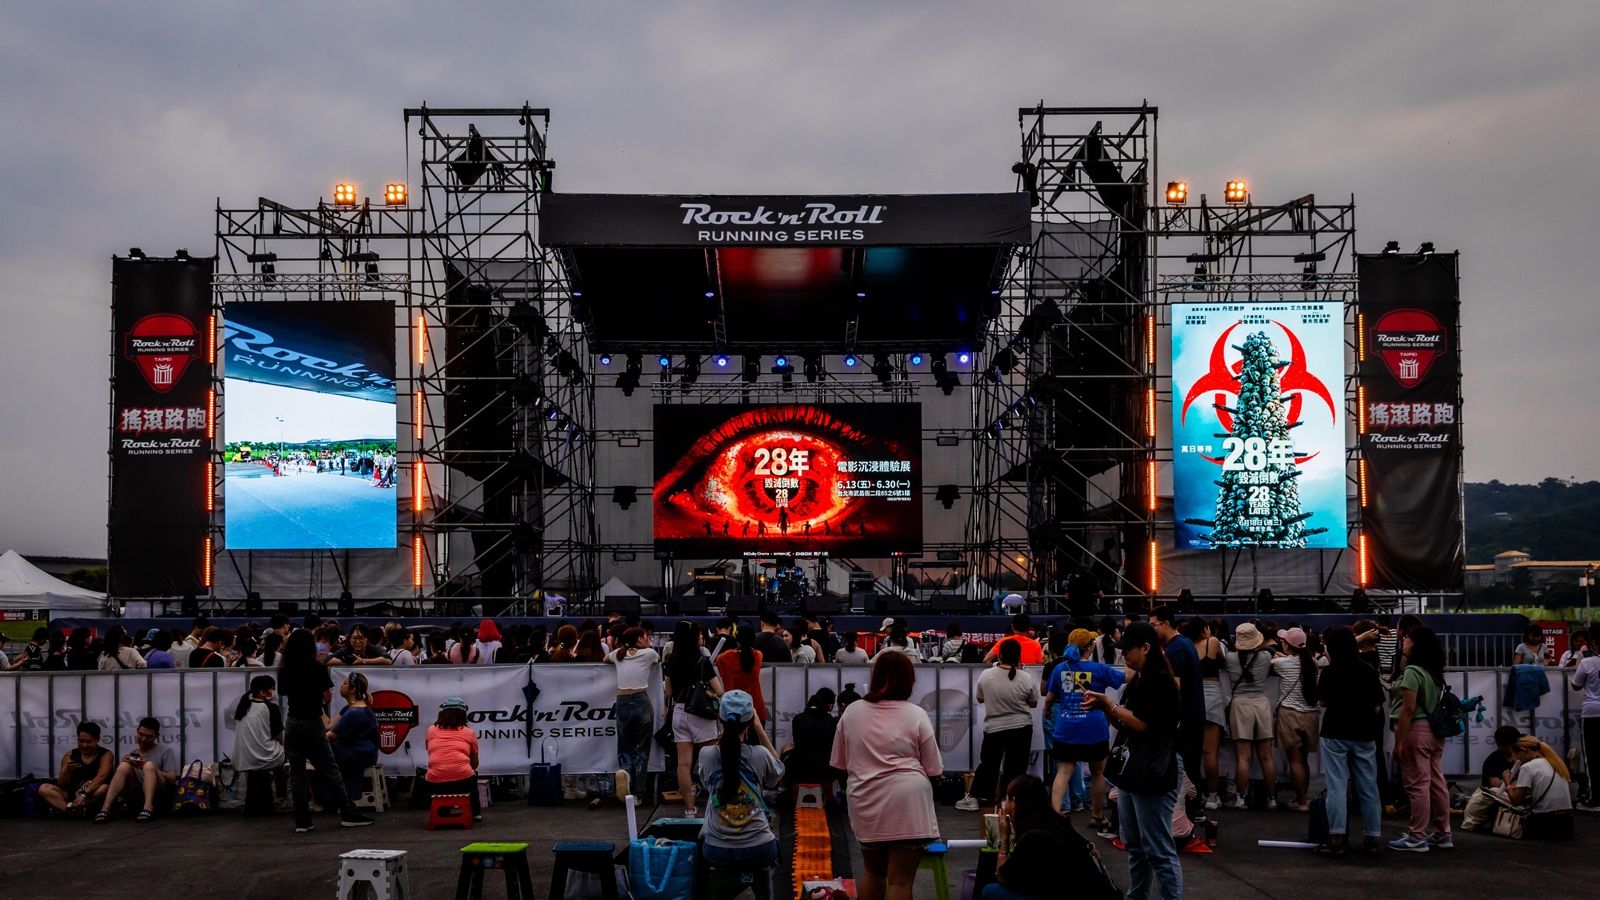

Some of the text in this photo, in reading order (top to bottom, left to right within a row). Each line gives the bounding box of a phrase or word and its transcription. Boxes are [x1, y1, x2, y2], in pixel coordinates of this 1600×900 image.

[698, 229, 864, 242] RUNNING SERIES
[233, 354, 360, 387] RUNNING
[122, 408, 206, 431] 搖滾路跑
[1369, 403, 1454, 426] 搖滾路跑
[754, 447, 809, 476] 28年
[1222, 436, 1294, 471] 28年
[837, 460, 911, 472] 電影沉浸體驗展
[775, 489, 788, 499] 28
[1248, 485, 1270, 502] 28
[1249, 507, 1270, 515] LATER
[477, 727, 616, 739] UNNING SERIES
